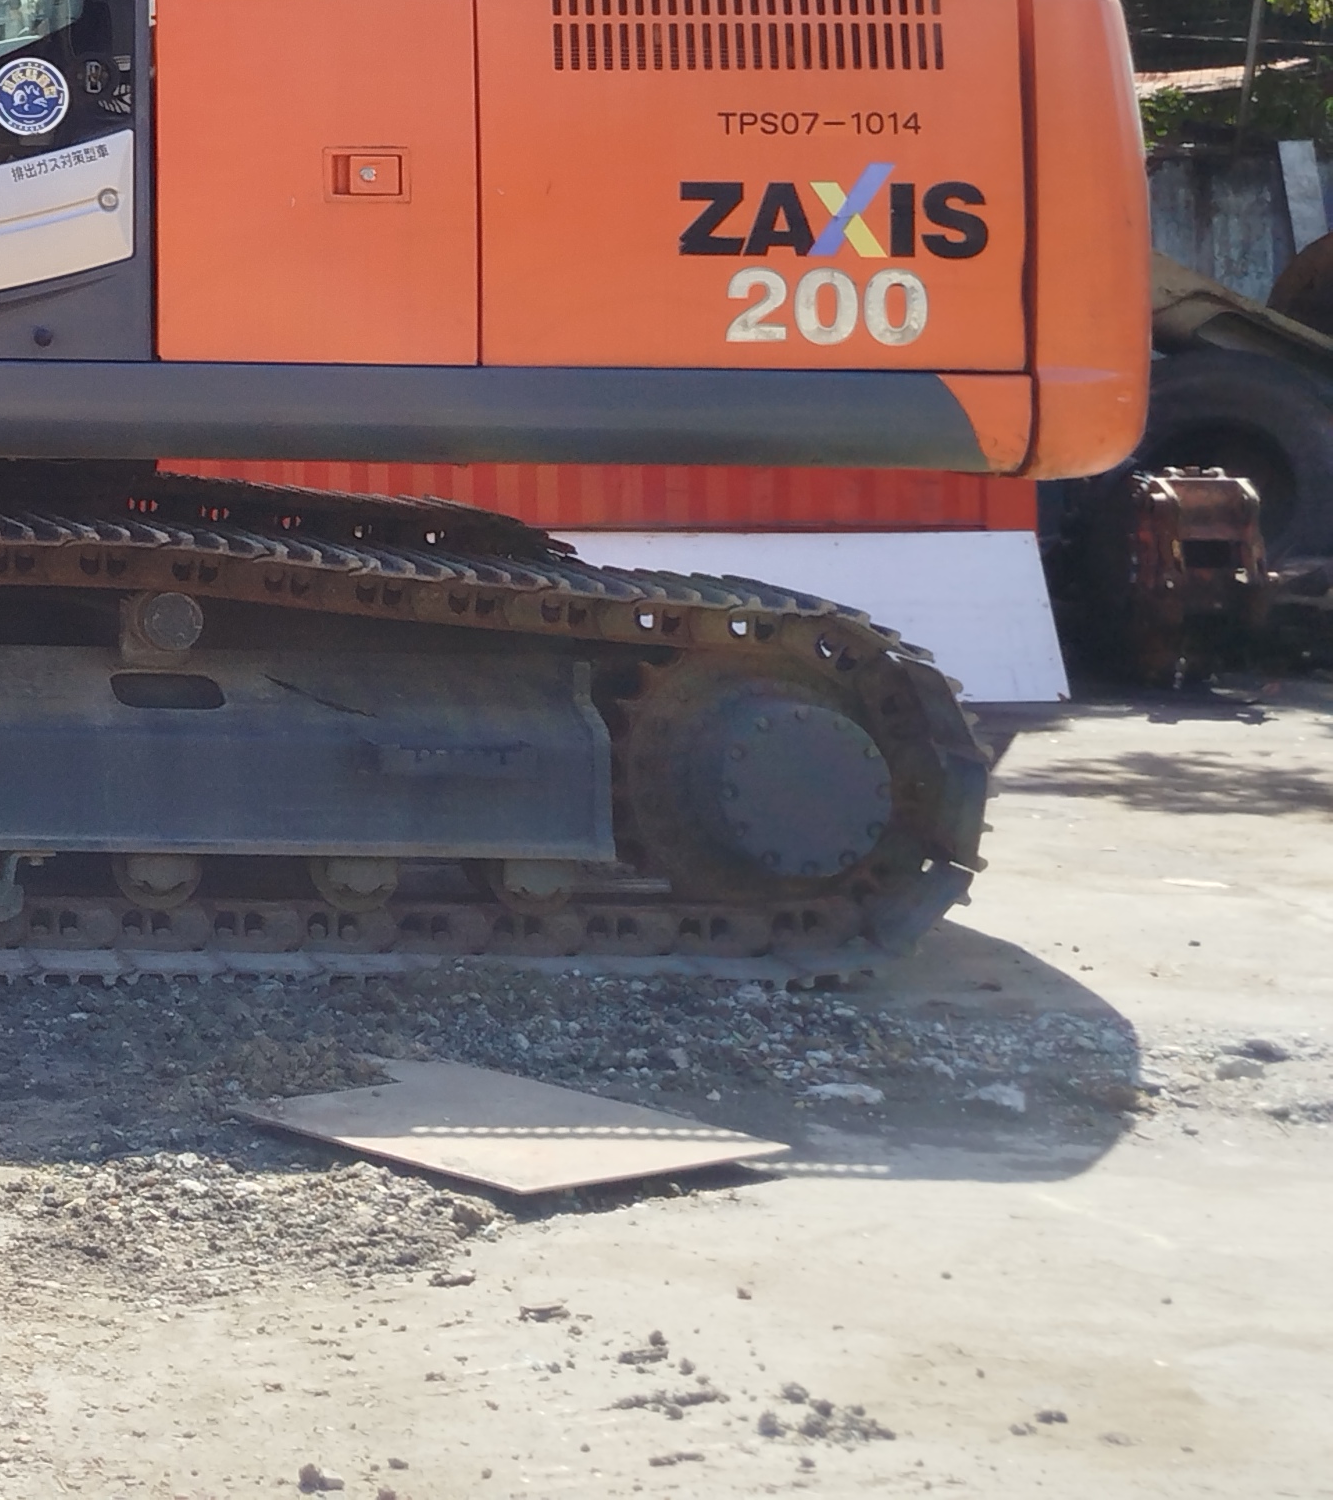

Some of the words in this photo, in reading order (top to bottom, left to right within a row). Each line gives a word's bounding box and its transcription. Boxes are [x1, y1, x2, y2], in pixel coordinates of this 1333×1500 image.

[717, 111, 922, 136] TPS07-1014
[679, 162, 989, 258] ZAXIS
[725, 267, 929, 346] 200
